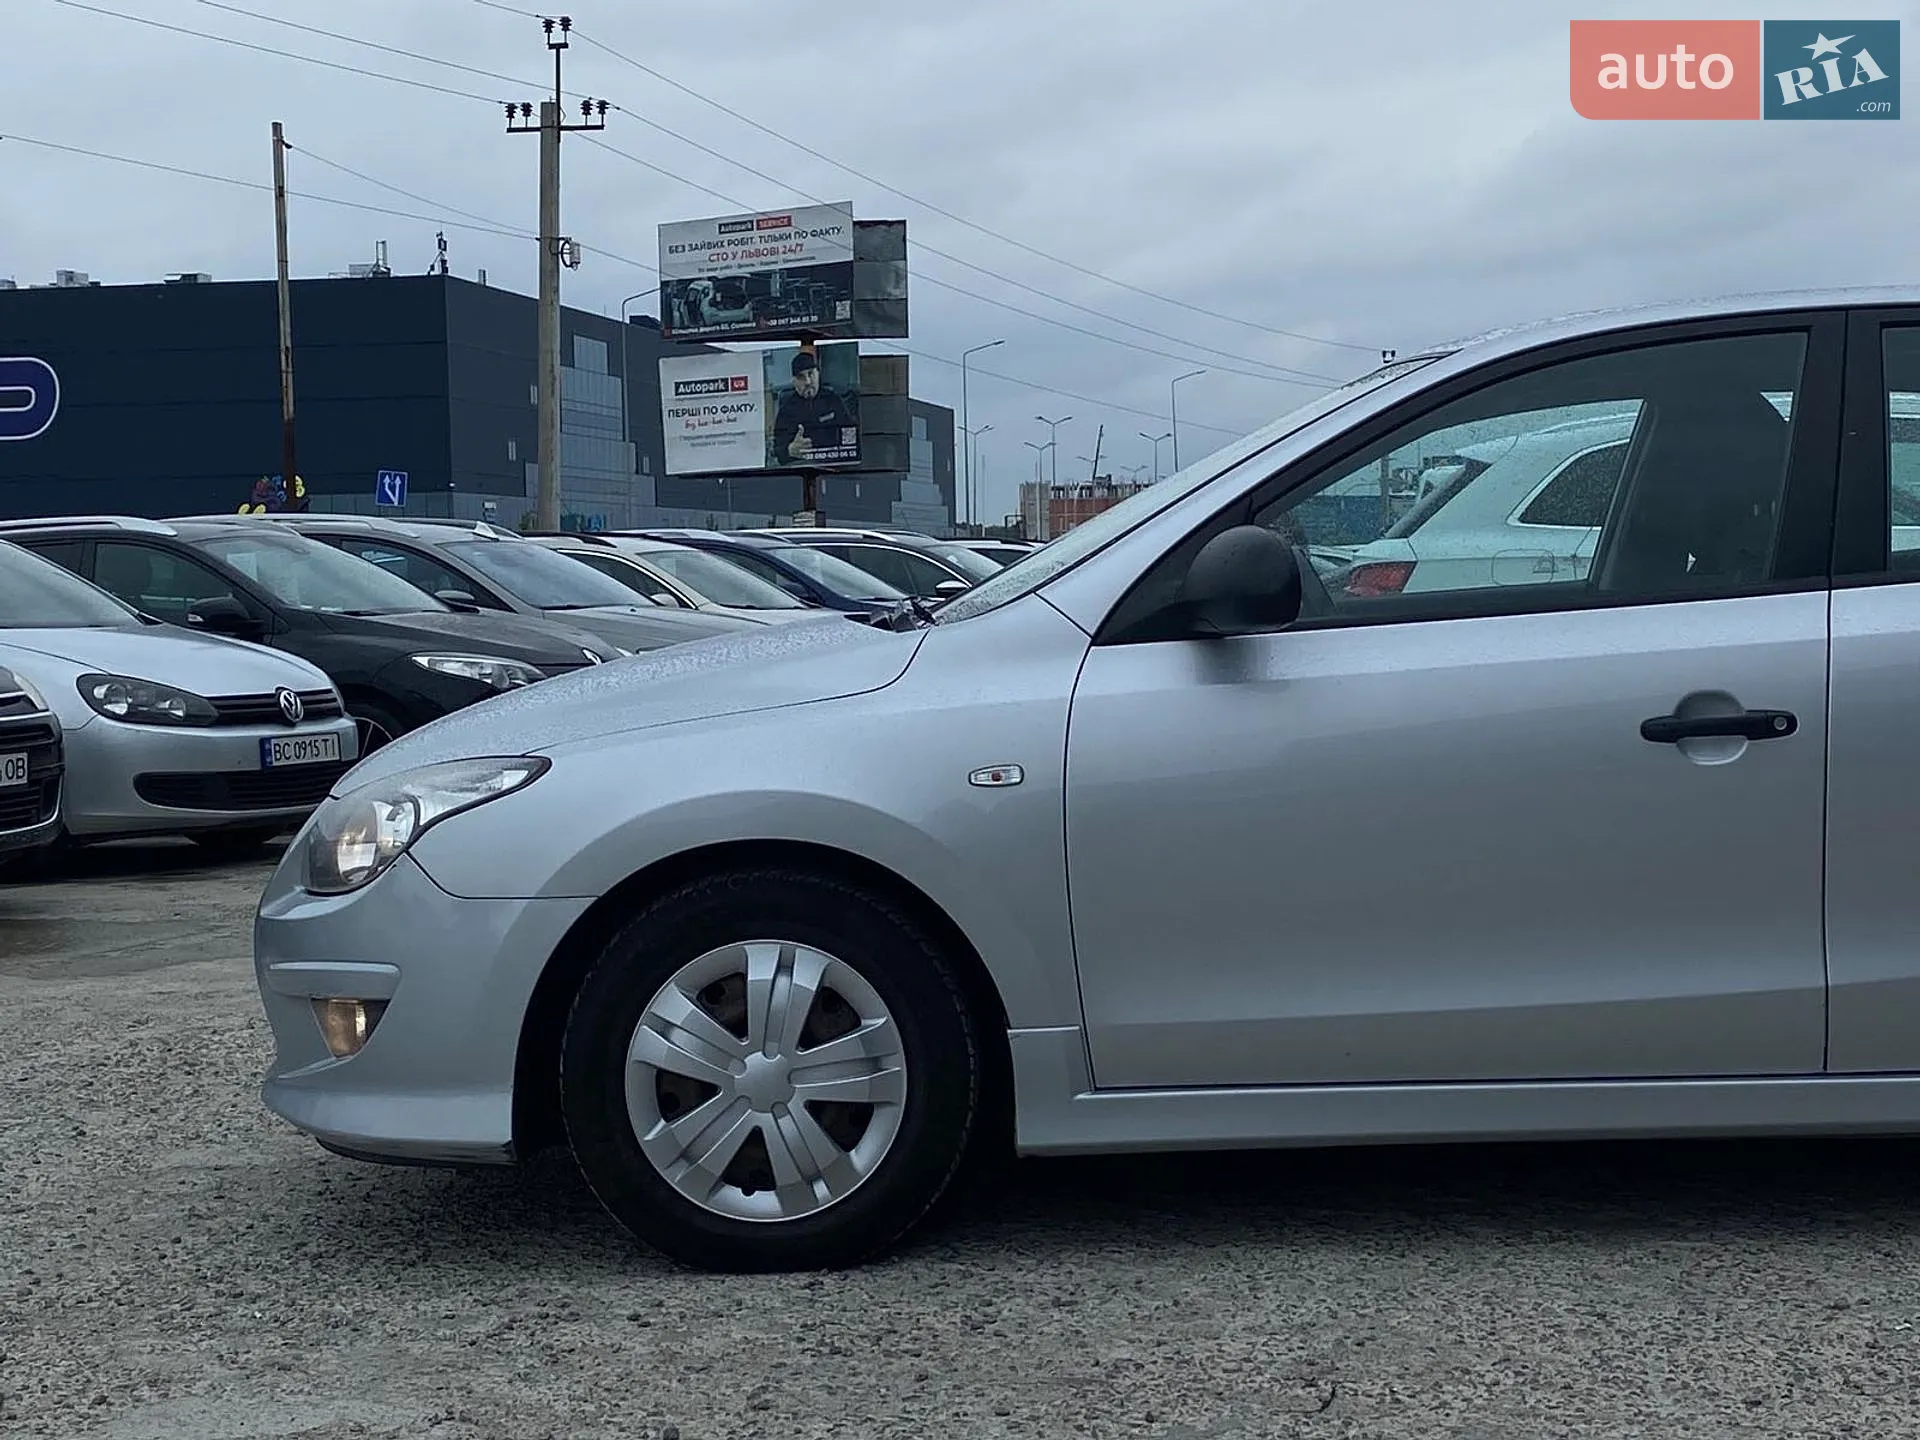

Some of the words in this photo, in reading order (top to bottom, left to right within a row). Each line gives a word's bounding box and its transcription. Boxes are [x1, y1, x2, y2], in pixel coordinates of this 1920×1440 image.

[668, 244, 686, 254] БЕЗ
[687, 240, 725, 252] ЗАЙВИХ
[759, 232, 792, 244] ТІЛЬКИ
[794, 230, 808, 239] ПО
[708, 251, 729, 262] СТО
[731, 250, 738, 260] У
[740, 246, 780, 260] ЛЬВОВІ
[782, 242, 804, 255] 24/7
[677, 380, 726, 394] Autopark
[668, 407, 701, 418] ПЕРШІ
[703, 405, 718, 416] ПО
[273, 742, 291, 762] BC
[293, 739, 320, 760] 0915
[321, 738, 335, 757] TI
